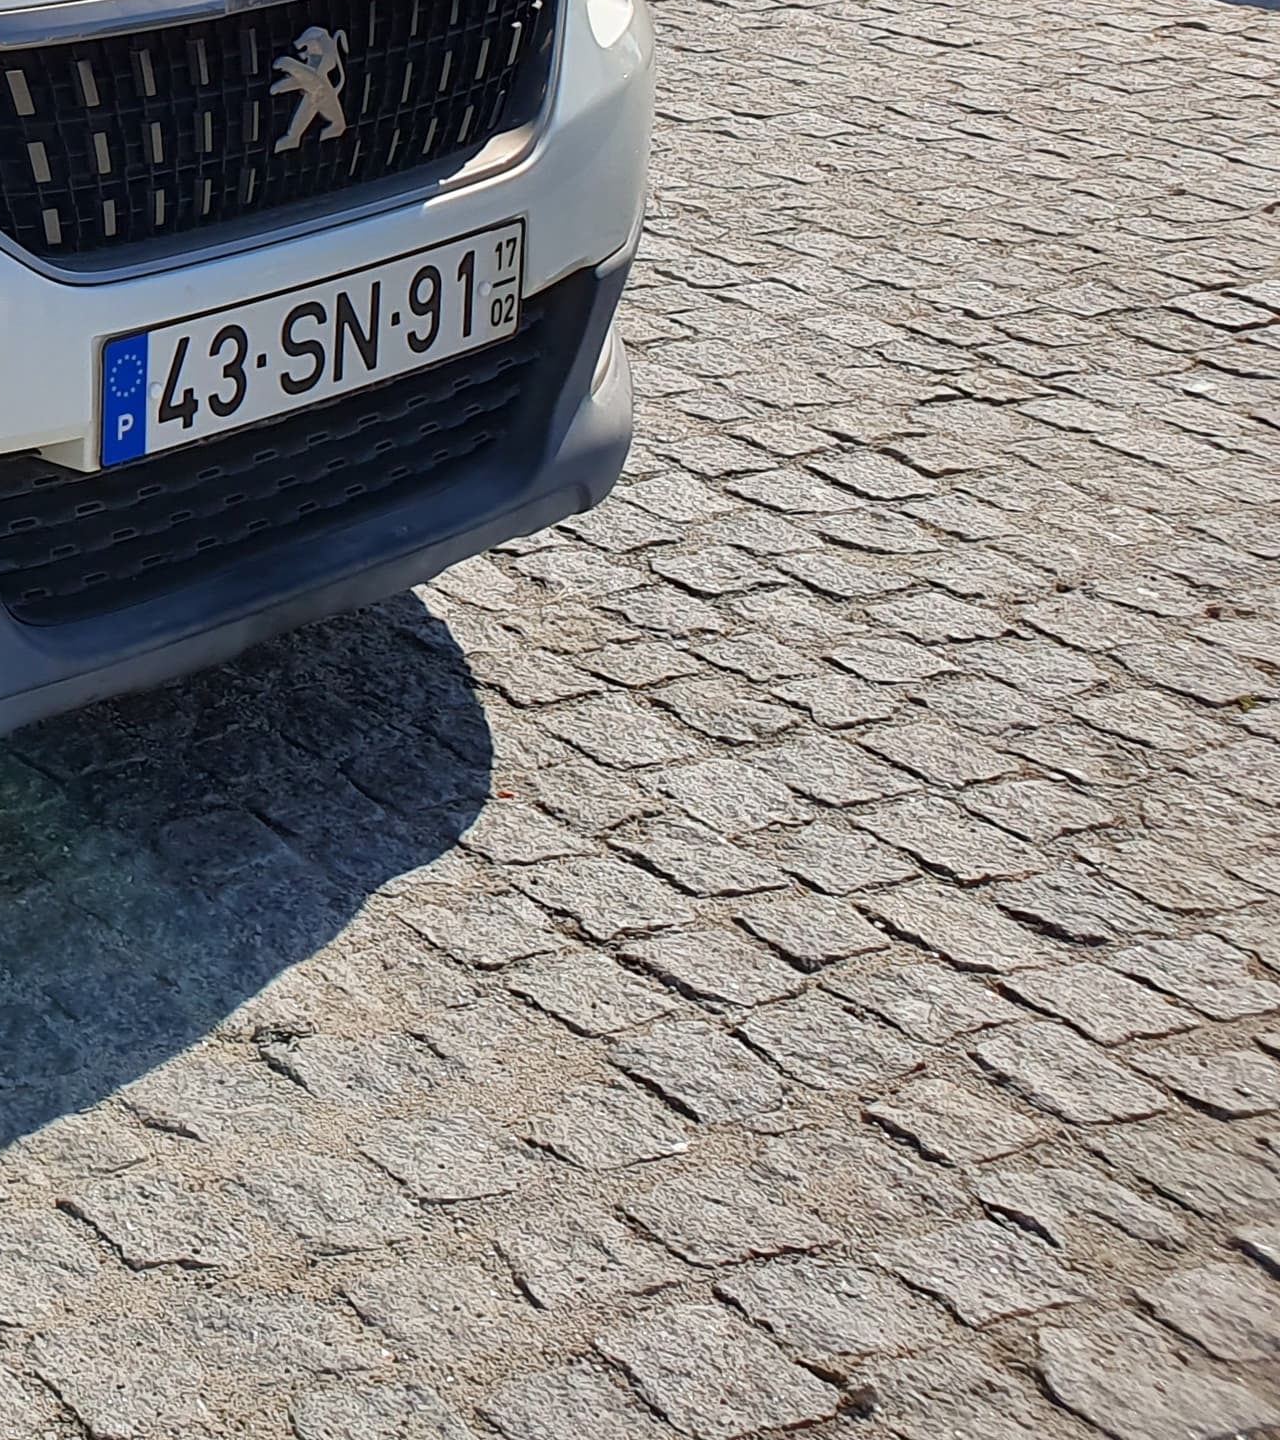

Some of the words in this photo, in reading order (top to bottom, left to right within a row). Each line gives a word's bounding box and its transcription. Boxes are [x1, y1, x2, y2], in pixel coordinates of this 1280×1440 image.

[494, 237, 518, 271] 17
[490, 293, 515, 327] 02
[116, 412, 135, 442] P
